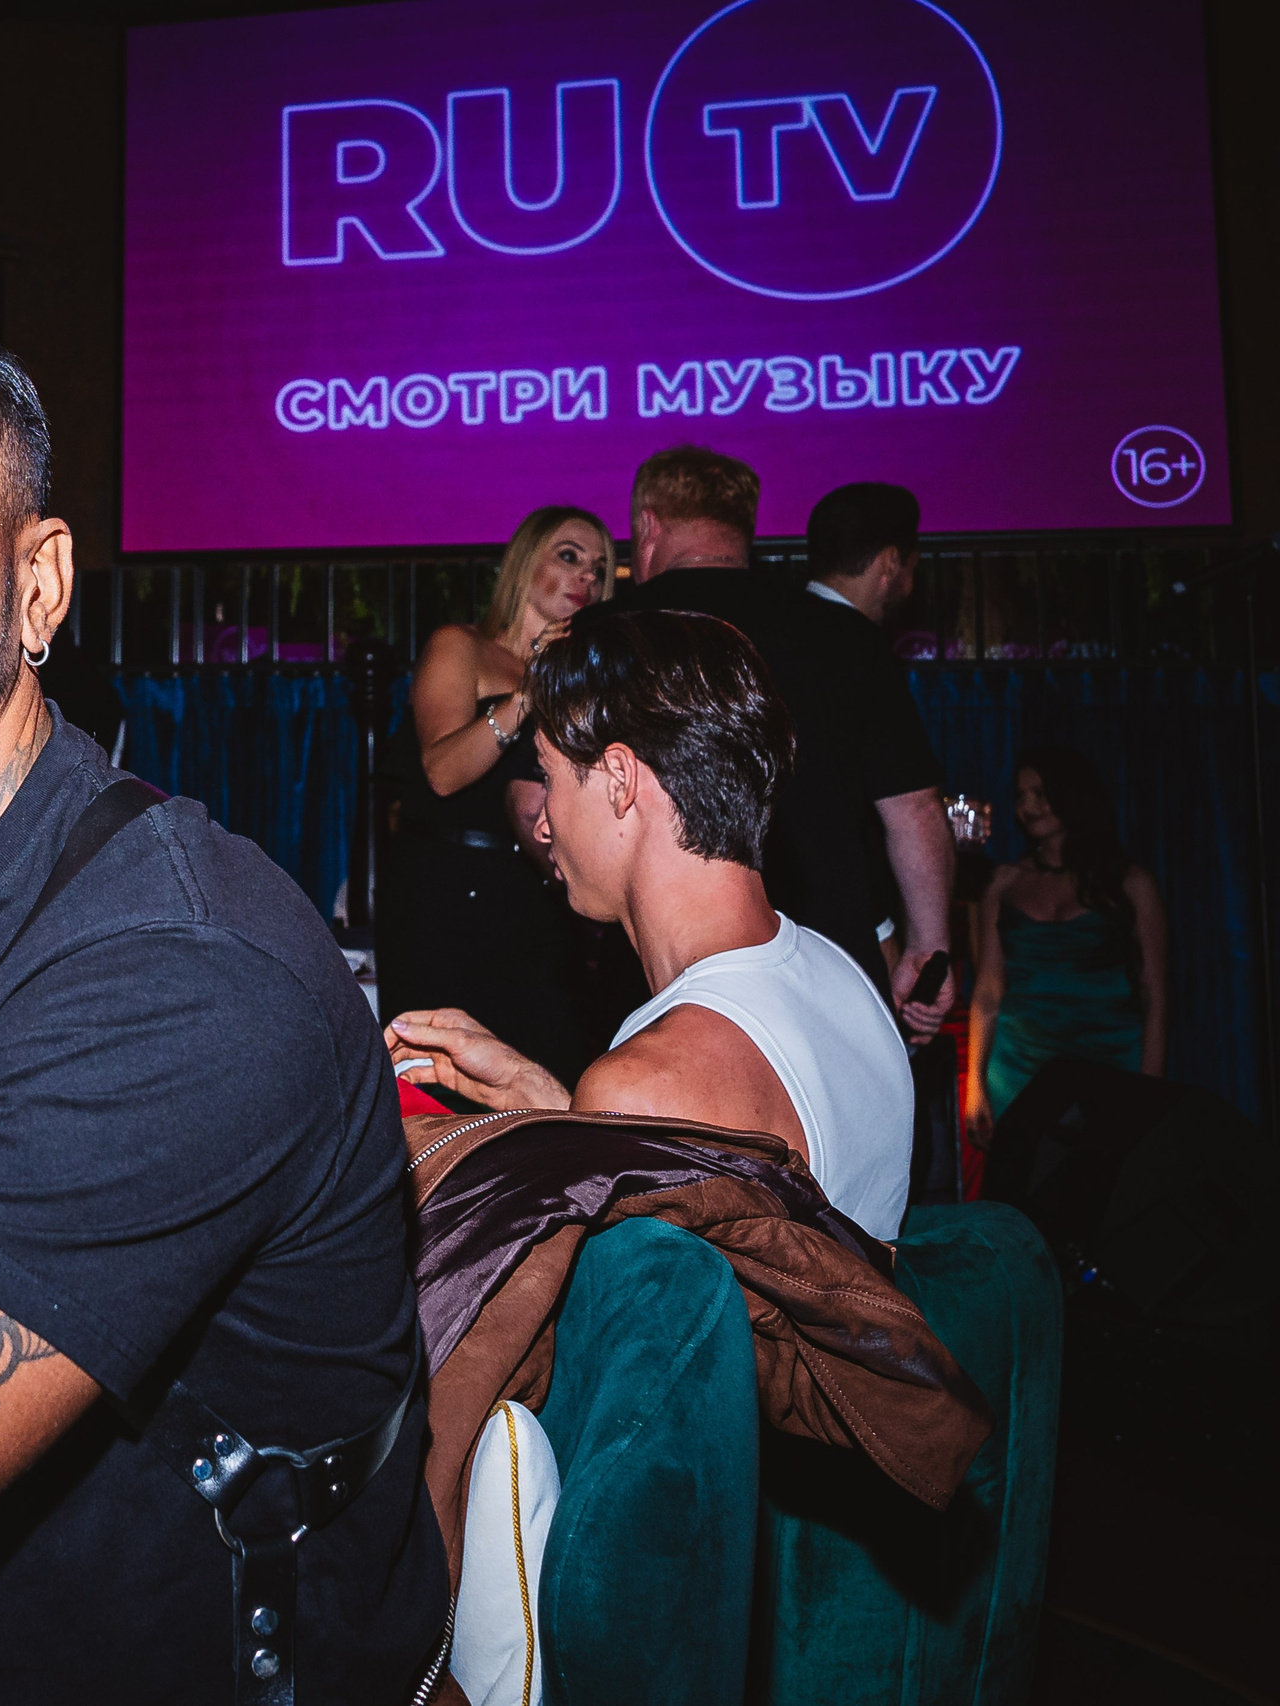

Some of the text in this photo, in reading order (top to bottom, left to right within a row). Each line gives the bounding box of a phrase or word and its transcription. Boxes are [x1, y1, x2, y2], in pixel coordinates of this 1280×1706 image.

[282, 78, 937, 266] RU TV
[274, 346, 1021, 432] СМОТРИ МУЗЫКУ
[1122, 447, 1196, 486] 16+
